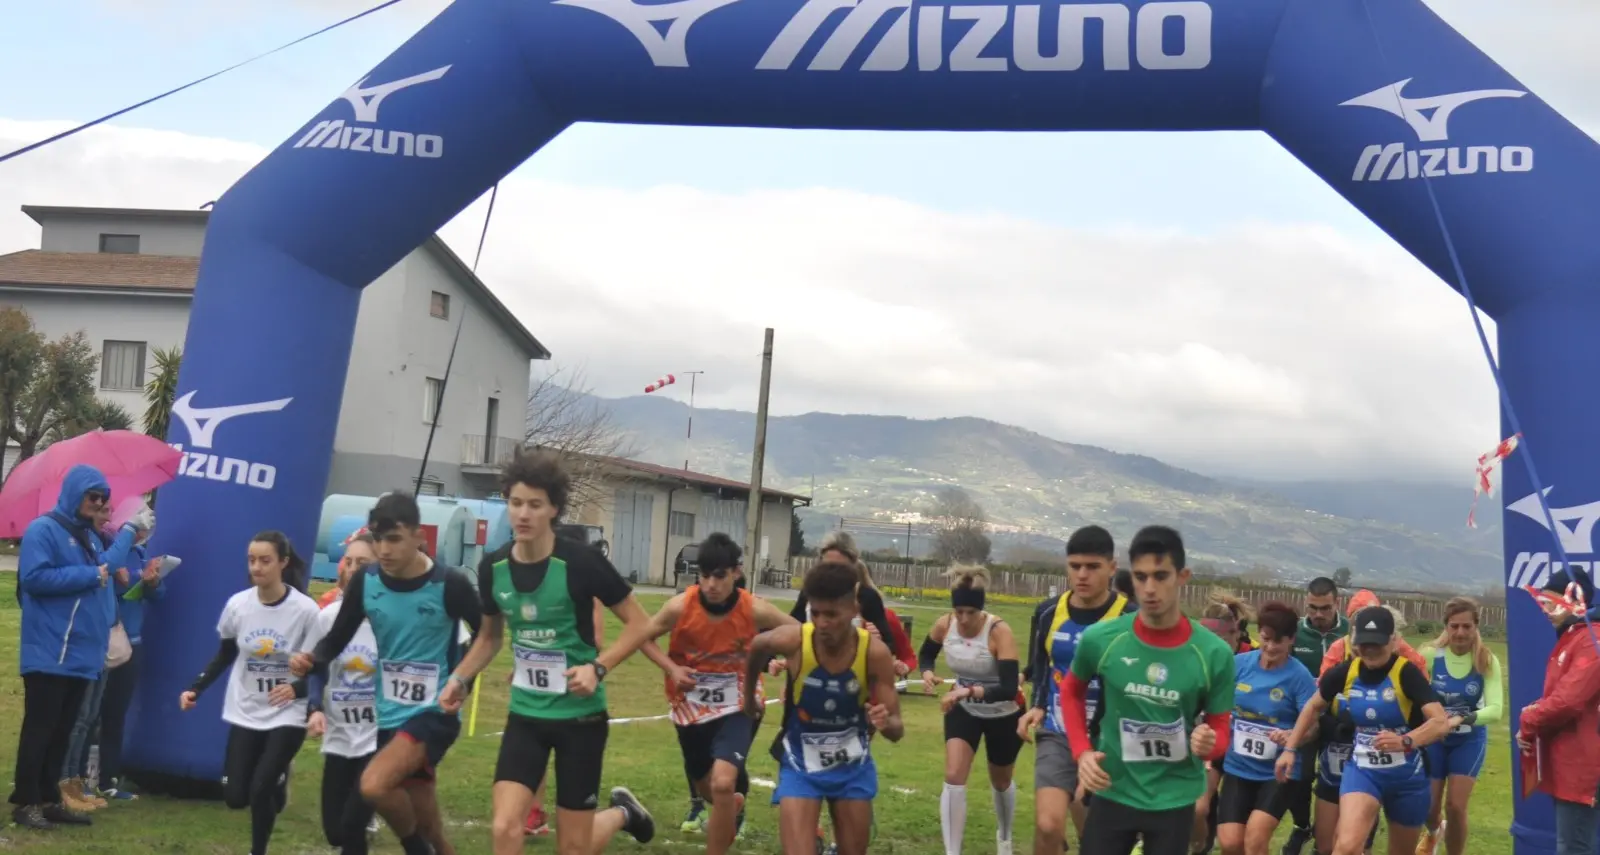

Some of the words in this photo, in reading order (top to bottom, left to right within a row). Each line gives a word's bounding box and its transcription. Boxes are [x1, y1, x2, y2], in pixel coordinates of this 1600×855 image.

[754, 0, 1212, 71] MIZUNO
[293, 119, 443, 158] MIZUNO
[1352, 142, 1533, 181] MIZUNO
[168, 443, 277, 490] IZUNO
[527, 667, 549, 687] 16
[391, 678, 426, 701] 128
[699, 687, 724, 702] 25
[1123, 681, 1179, 700] AIELLO
[341, 706, 374, 724] 114
[1140, 739, 1171, 757] 18
[1242, 738, 1265, 756] 49
